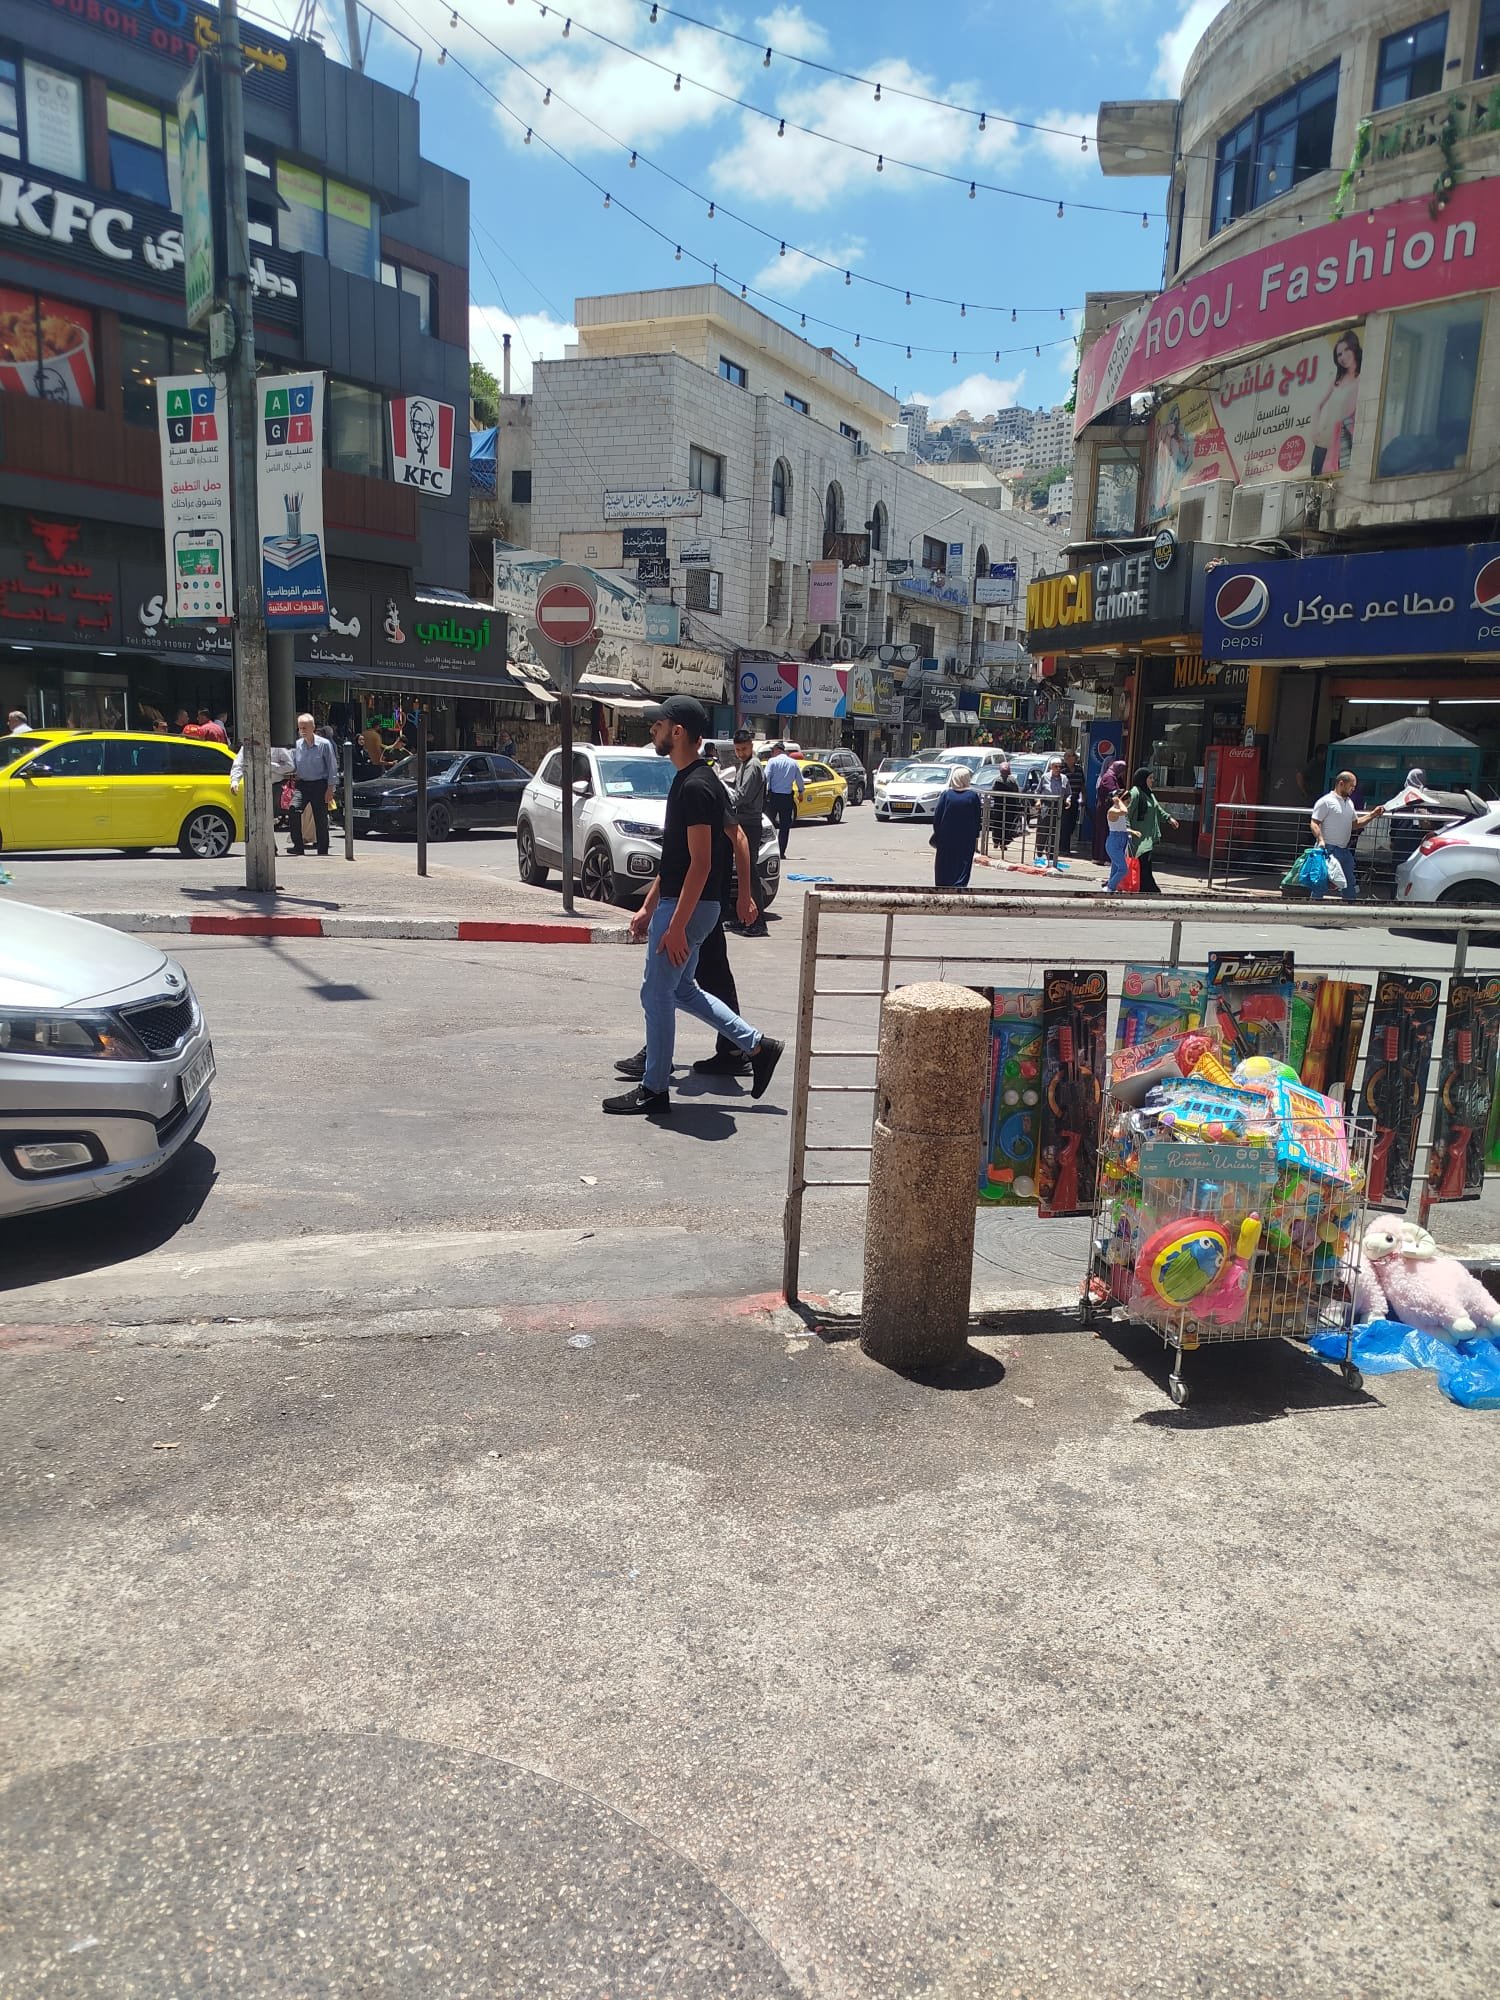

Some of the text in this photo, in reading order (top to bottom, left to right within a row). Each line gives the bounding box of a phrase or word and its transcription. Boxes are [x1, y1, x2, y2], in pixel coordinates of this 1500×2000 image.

[0, 172, 133, 260] KFC
[1145, 220, 1477, 359] ROOJ Fashion
[1220, 355, 1319, 409] روج فاشن
[1256, 404, 1290, 421] بمناسبة
[1295, 415, 1312, 428] عيد
[1262, 417, 1294, 435] الأضحى
[1234, 427, 1261, 445] المبارك
[403, 463, 443, 490] KFC
[170, 480, 222, 494] حمل التطبيق
[266, 584, 322, 598] قسم القرطاسية
[1025, 571, 1093, 632] MUCA
[1096, 556, 1150, 591] CAFE
[1284, 593, 1455, 628] مطاعم عوكل
[416, 616, 491, 652] أرجيلتي
[1221, 634, 1264, 650] pepsi
[196, 637, 233, 653] طابون
[310, 649, 354, 663] معجنات
[1214, 961, 1283, 985] Police
[1212, 1154, 1257, 1169] Unicorn
